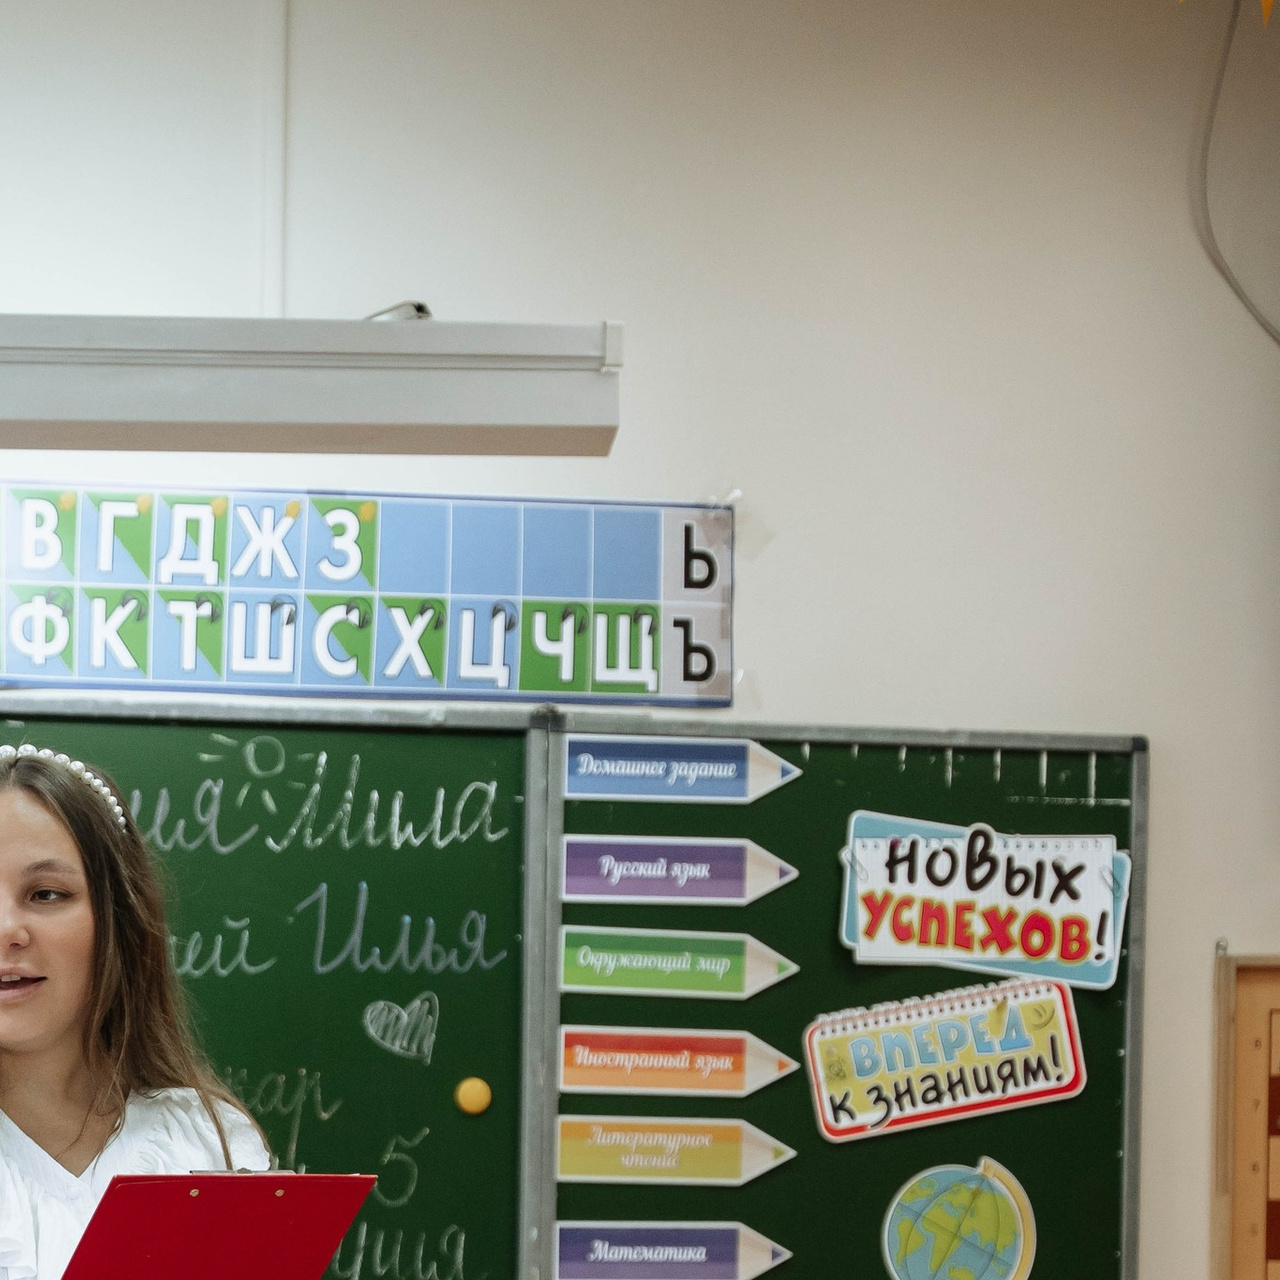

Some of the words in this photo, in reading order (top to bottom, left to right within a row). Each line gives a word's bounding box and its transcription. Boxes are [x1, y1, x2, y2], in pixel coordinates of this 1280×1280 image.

[671, 862, 710, 888] язык
[860, 890, 1110, 963] УСПЕХОВ!
[696, 956, 731, 981] мир
[694, 1054, 734, 1079] язык
[587, 1239, 708, 1263] Математика
